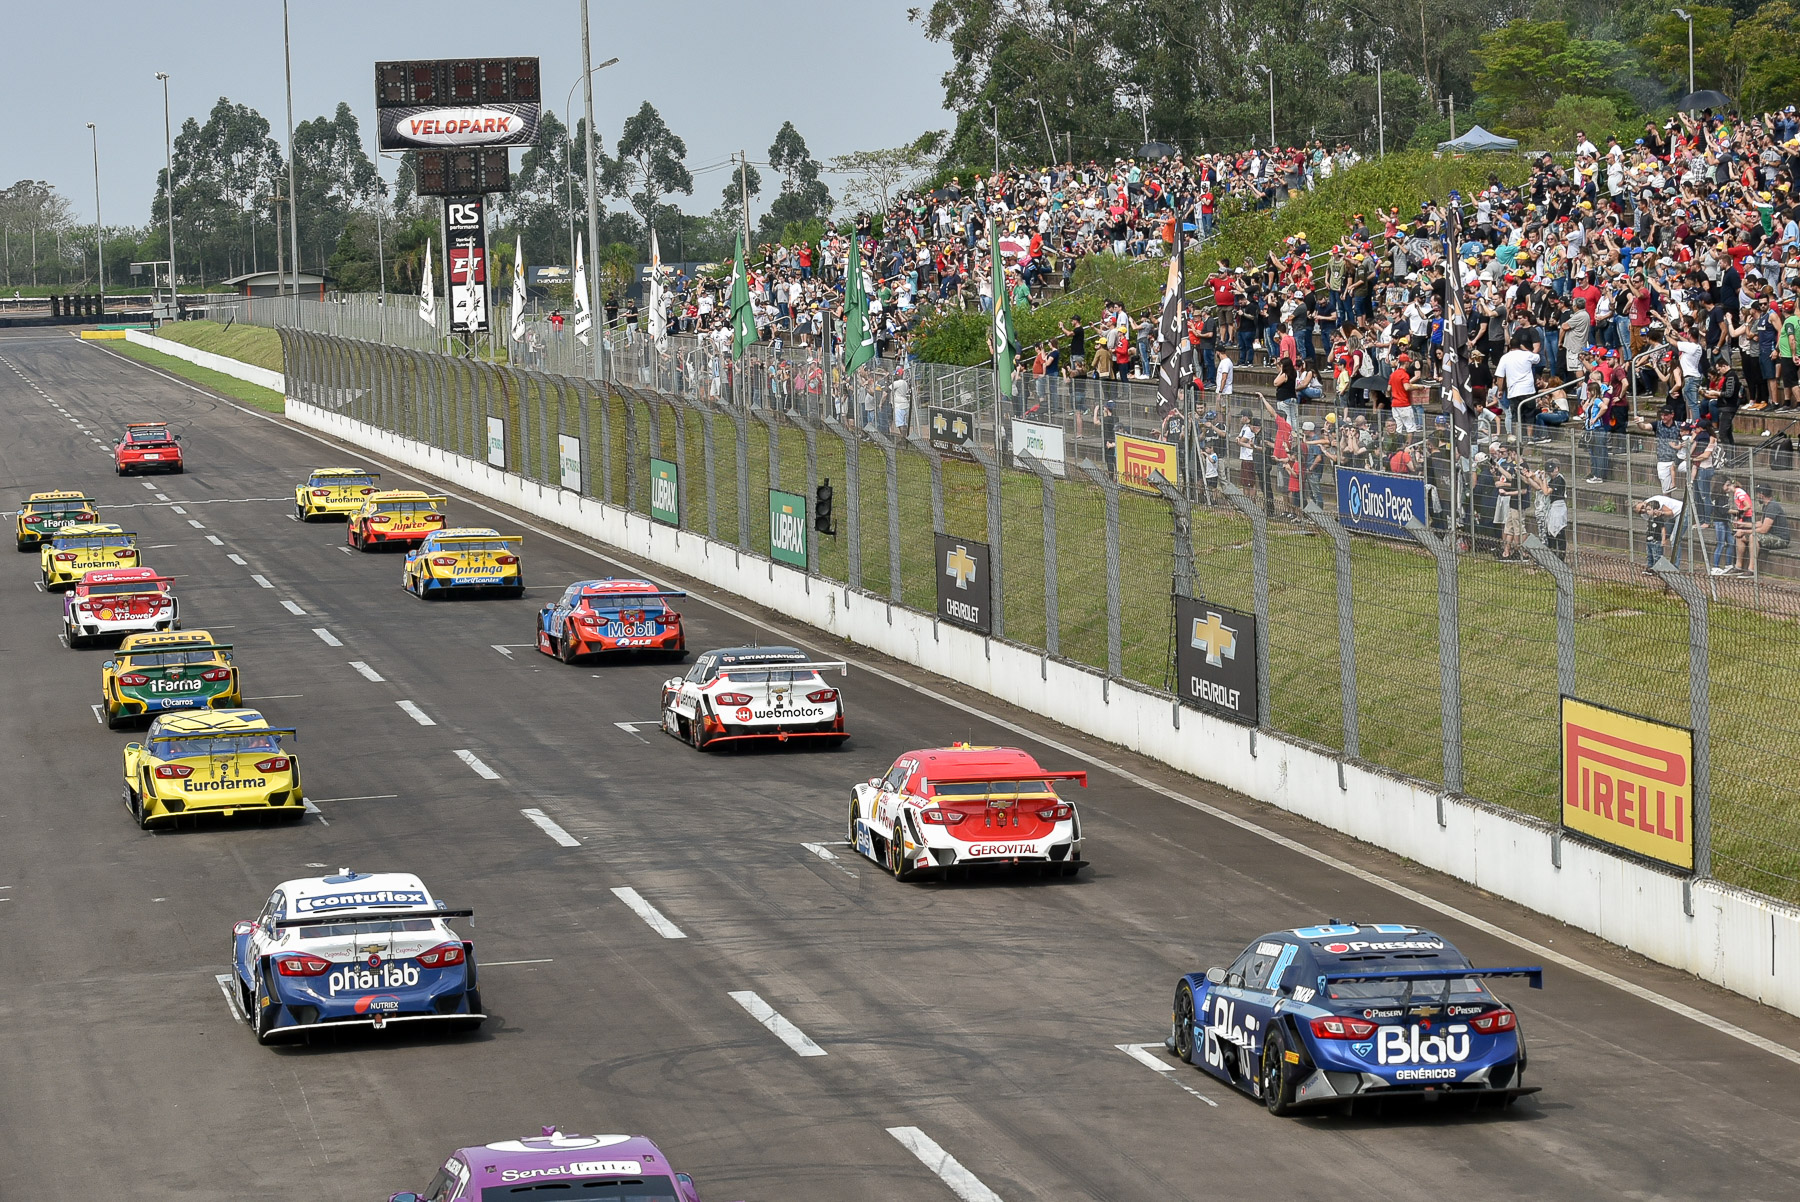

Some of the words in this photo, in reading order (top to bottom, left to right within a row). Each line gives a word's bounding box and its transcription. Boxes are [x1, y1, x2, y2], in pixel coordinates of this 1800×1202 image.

[410, 116, 511, 136] VELOPARK
[449, 203, 479, 225] RS
[325, 496, 365, 504] Eurofarma
[652, 477, 677, 514] LUBRAX
[1362, 483, 1385, 518] Giros
[1385, 487, 1413, 528] Peças
[43, 519, 76, 528] 1Farma
[391, 522, 428, 532] Jupiter
[771, 510, 805, 556] LUBRAX
[71, 560, 120, 569] Eurofarma
[453, 565, 503, 575] Ipiranga
[946, 598, 979, 624] CHEVROLET
[608, 620, 656, 637] Mobil
[135, 635, 206, 643] CIMED
[630, 638, 652, 646] ALE
[149, 679, 202, 692] 1Farma
[1191, 676, 1241, 711] CHEVROLET
[754, 707, 824, 719] webmotors
[183, 777, 267, 792] Eurofarma
[1566, 722, 1686, 843] PIRELLI
[969, 844, 1038, 857] GEROVITAL
[312, 890, 424, 908] contuflex
[1348, 941, 1444, 952] PRESERV
[329, 962, 419, 997] pharlab
[370, 1001, 399, 1010] NUTRIEX
[1455, 1006, 1483, 1015] PRESERV
[1372, 1009, 1403, 1018] PRESERV
[1396, 1068, 1456, 1080] GENÉRICOS
